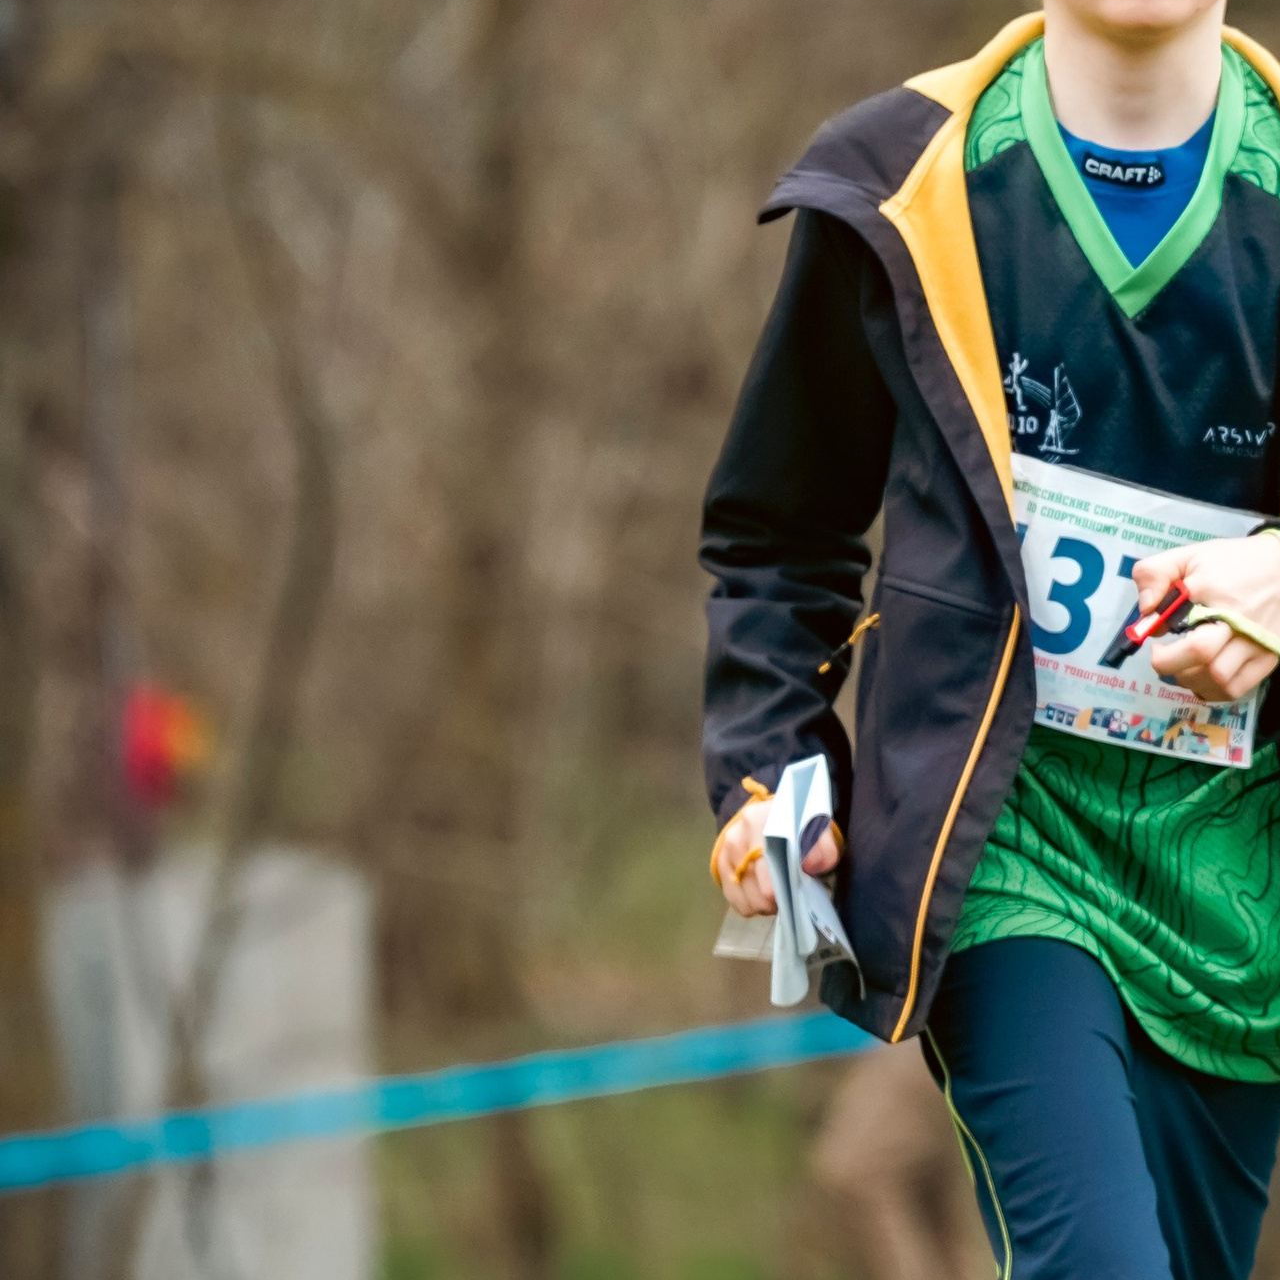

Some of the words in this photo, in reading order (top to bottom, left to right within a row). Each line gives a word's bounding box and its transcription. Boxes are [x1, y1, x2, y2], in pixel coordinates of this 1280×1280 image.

[1085, 158, 1147, 182] CRAFT
[1013, 481, 1092, 512] СЕРОССИЙСКИЕ
[1094, 504, 1166, 533] СПОРТИВНЫЕ
[1168, 525, 1218, 542] СОРЕВНО
[1041, 506, 1119, 536] СПОРТИВНОМУ
[1122, 529, 1184, 550] ОРИЕНТИР
[1064, 664, 1126, 689] топографа
